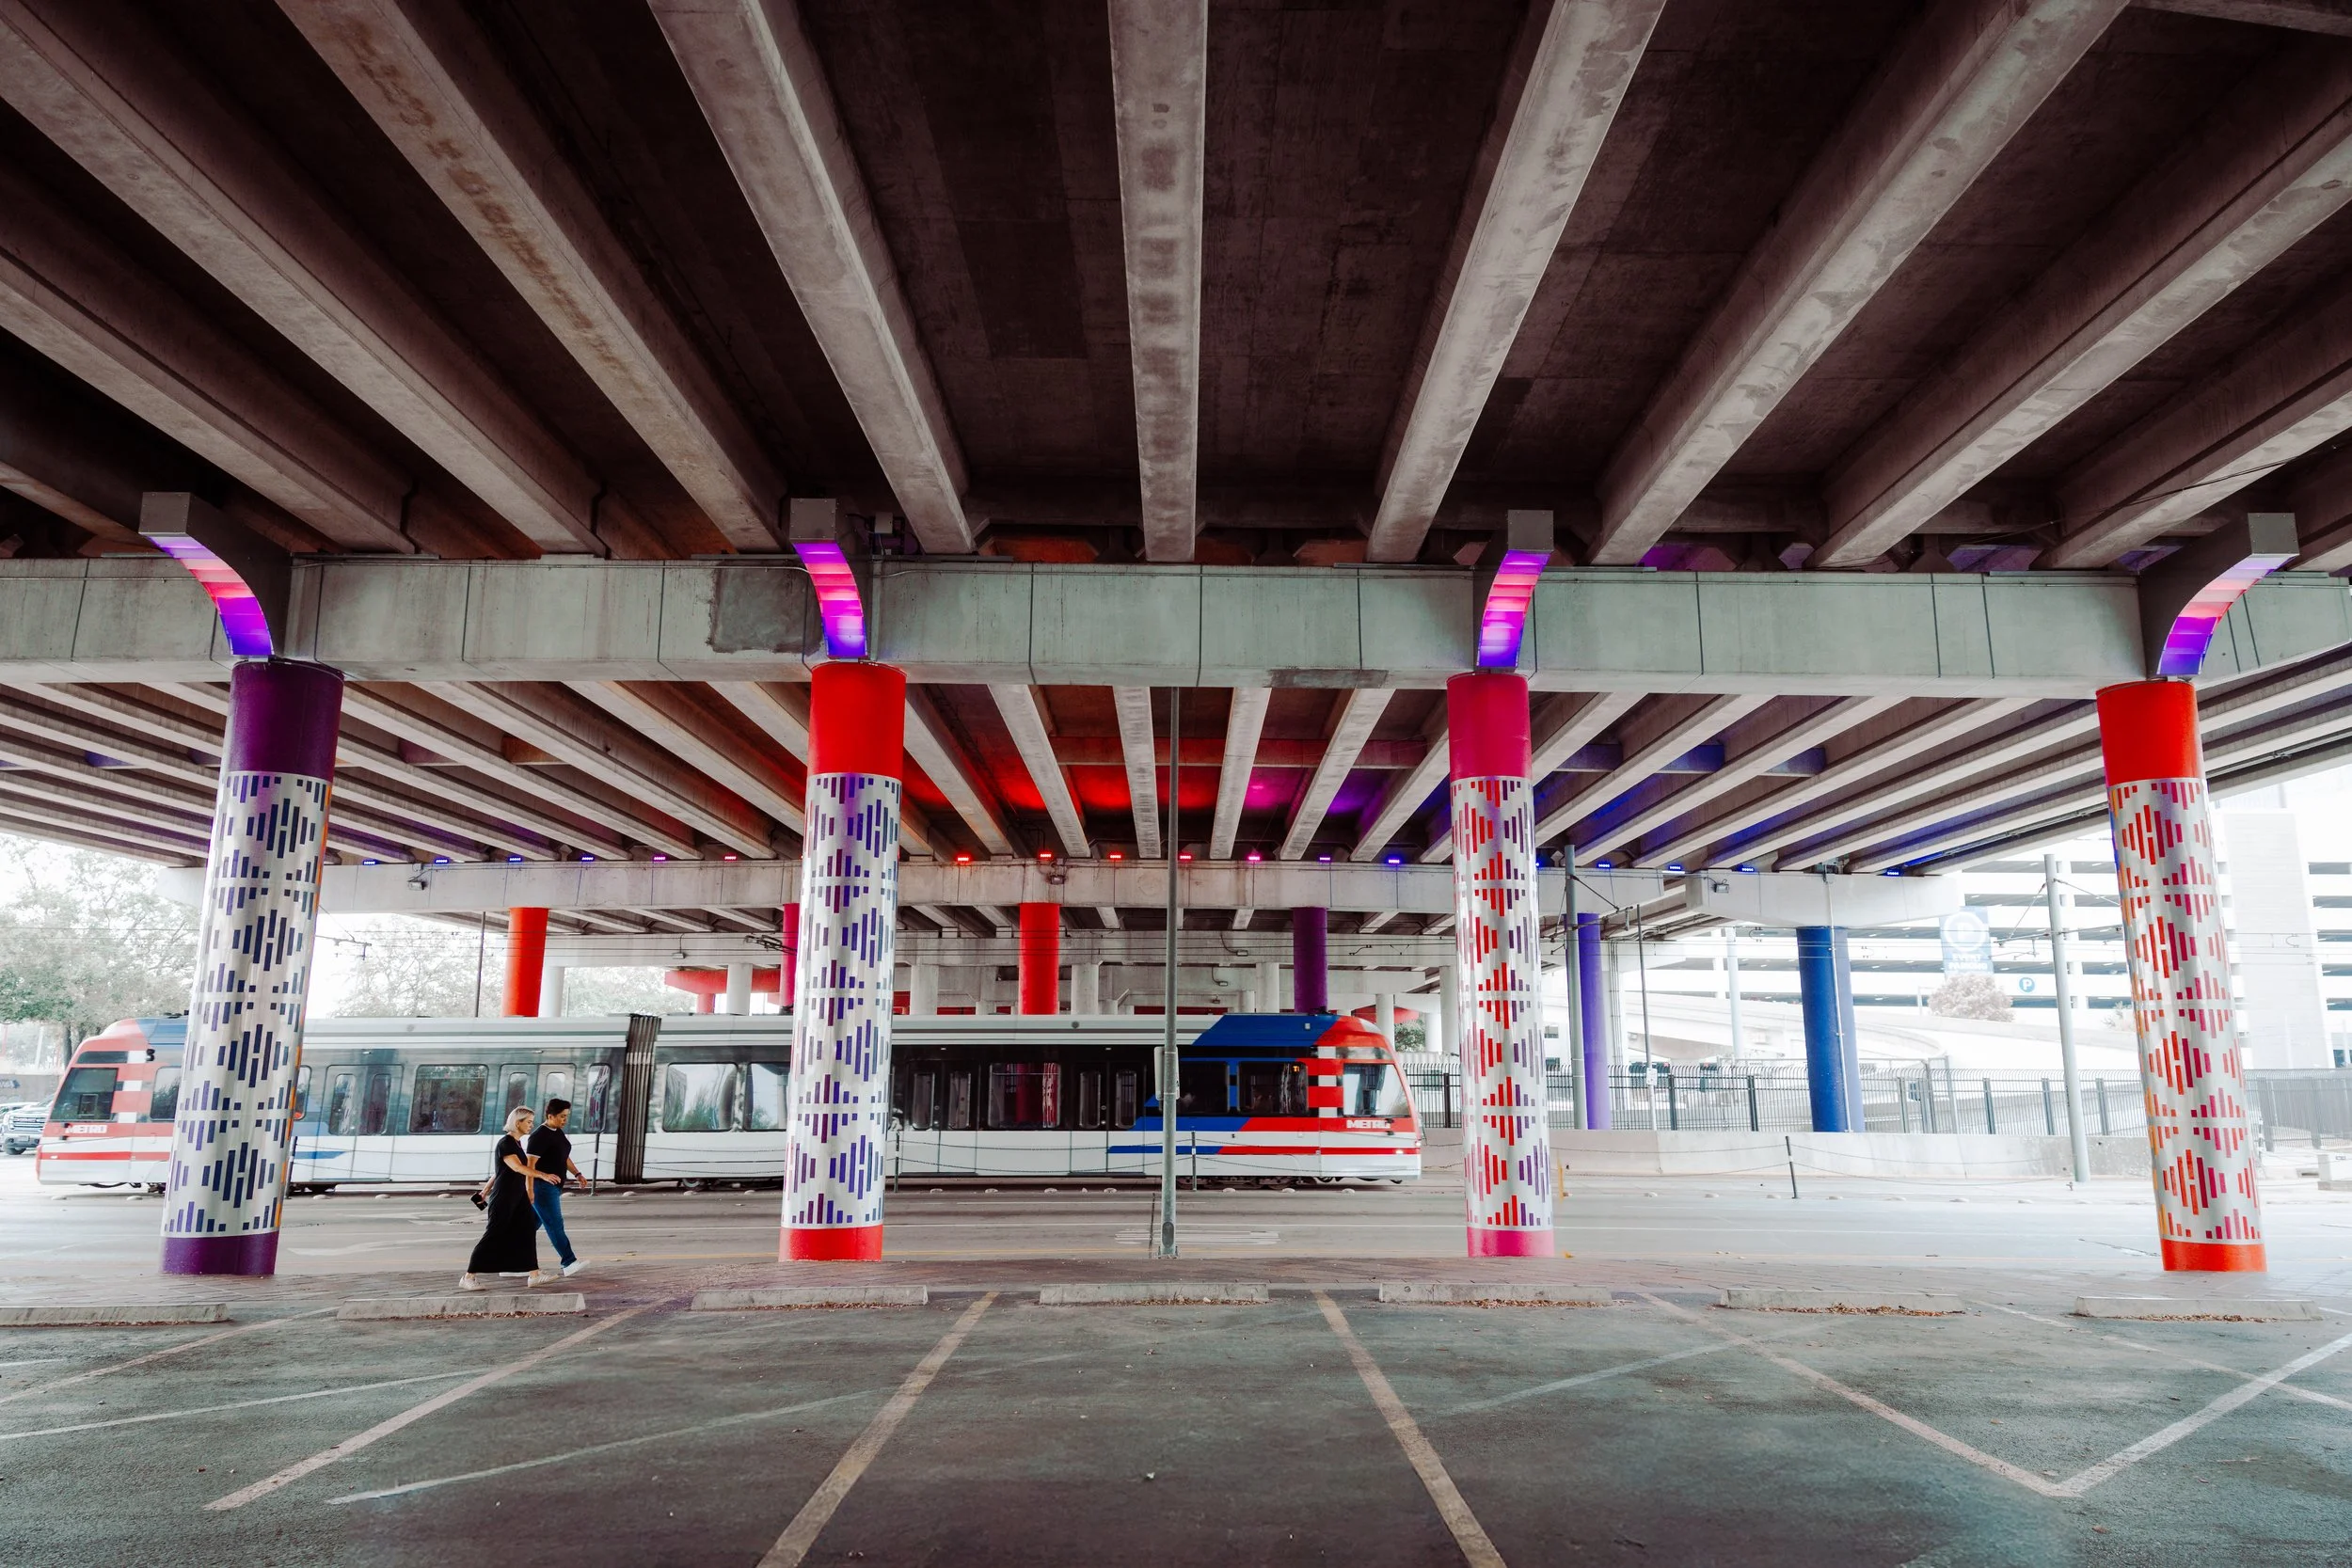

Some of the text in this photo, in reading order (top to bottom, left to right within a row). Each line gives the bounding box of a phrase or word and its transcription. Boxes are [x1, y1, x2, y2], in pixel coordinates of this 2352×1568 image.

[1948, 961, 1988, 970] PARKING
[65, 1124, 107, 1133] METRO
[1346, 1119, 1391, 1129] METRO
